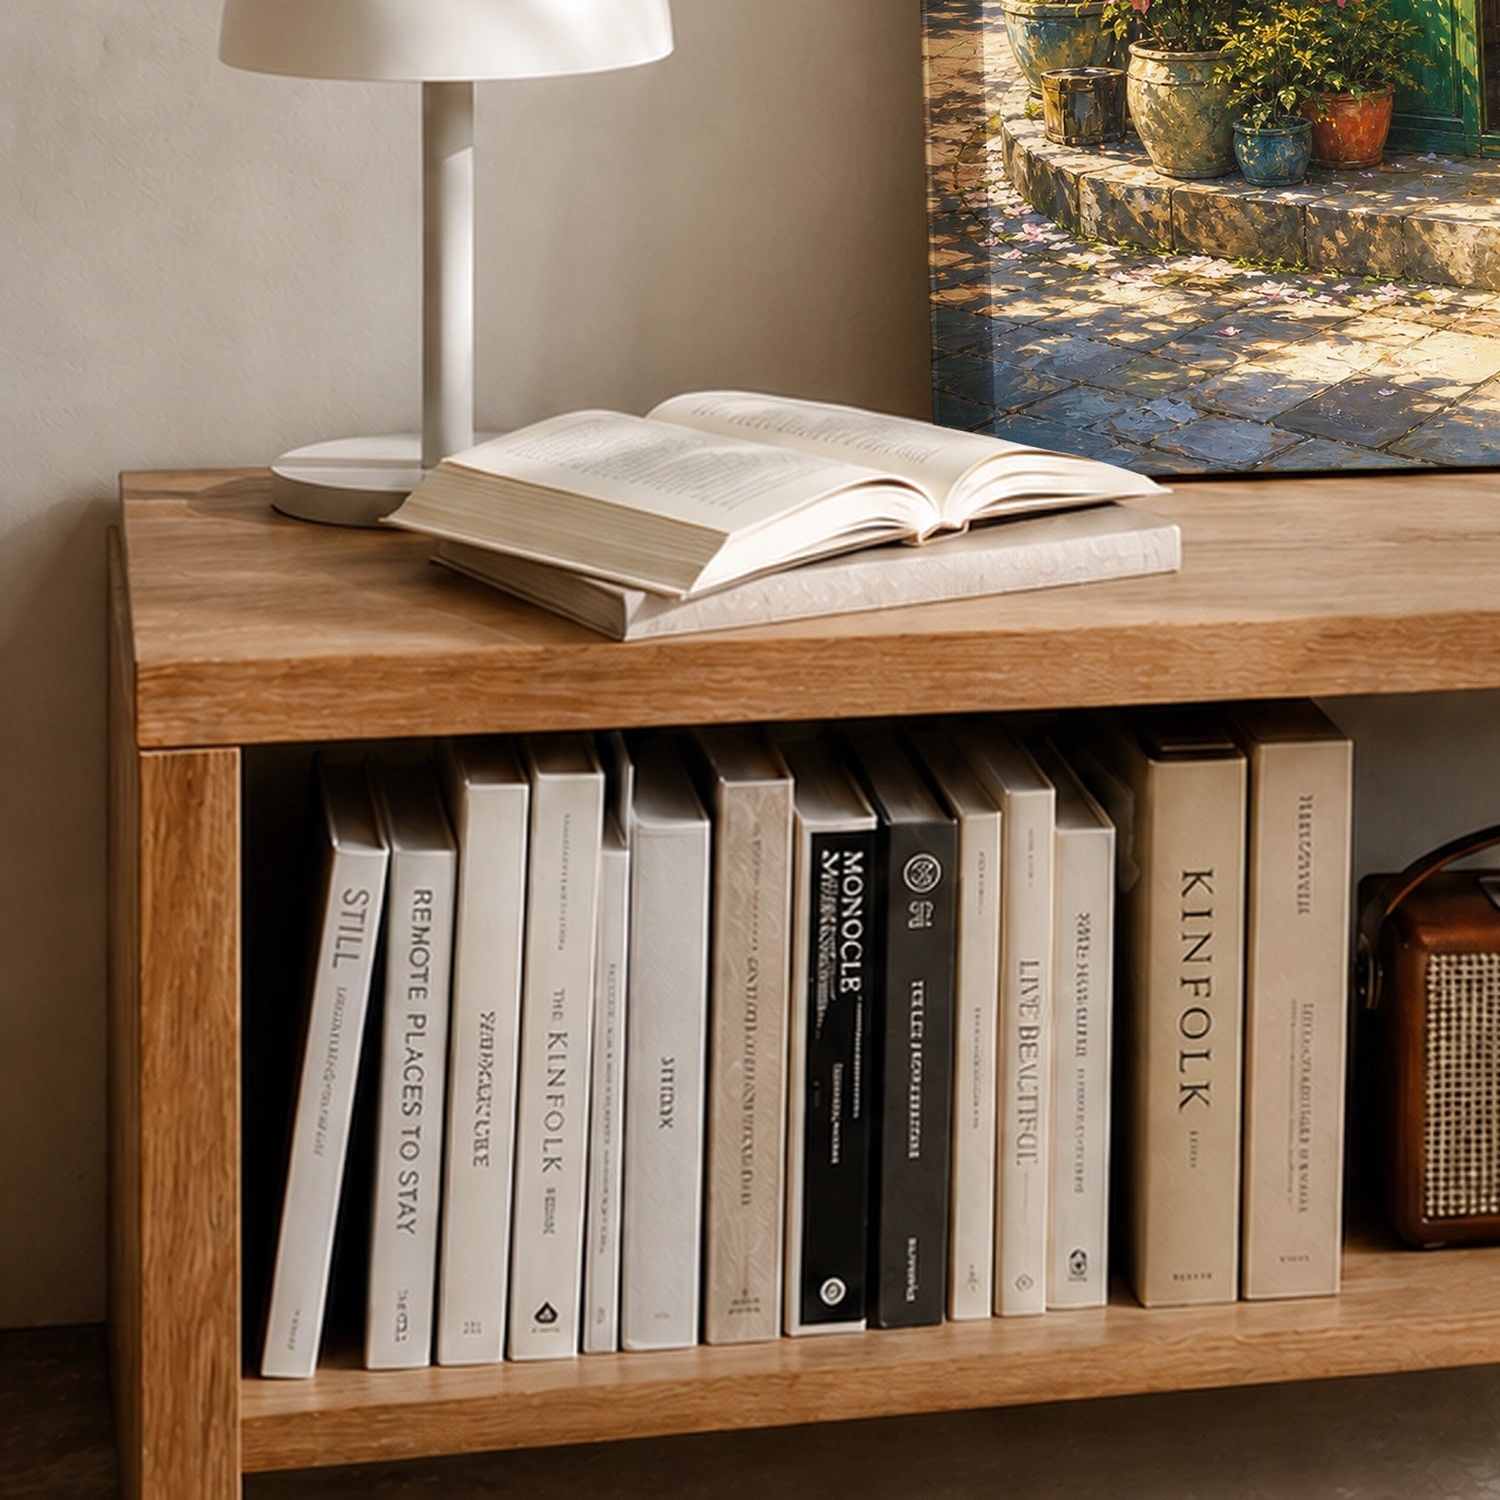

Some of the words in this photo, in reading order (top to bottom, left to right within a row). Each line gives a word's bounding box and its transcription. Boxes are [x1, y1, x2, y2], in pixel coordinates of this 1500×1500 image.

[332, 889, 370, 969] STILL
[409, 889, 433, 1000] REMOTE
[1178, 868, 1214, 1113] KINFOLK
[402, 1013, 427, 1116] PLACES
[542, 1031, 568, 1174] KINFOLK
[400, 1125, 421, 1160] TO
[396, 1171, 418, 1235] STAY
